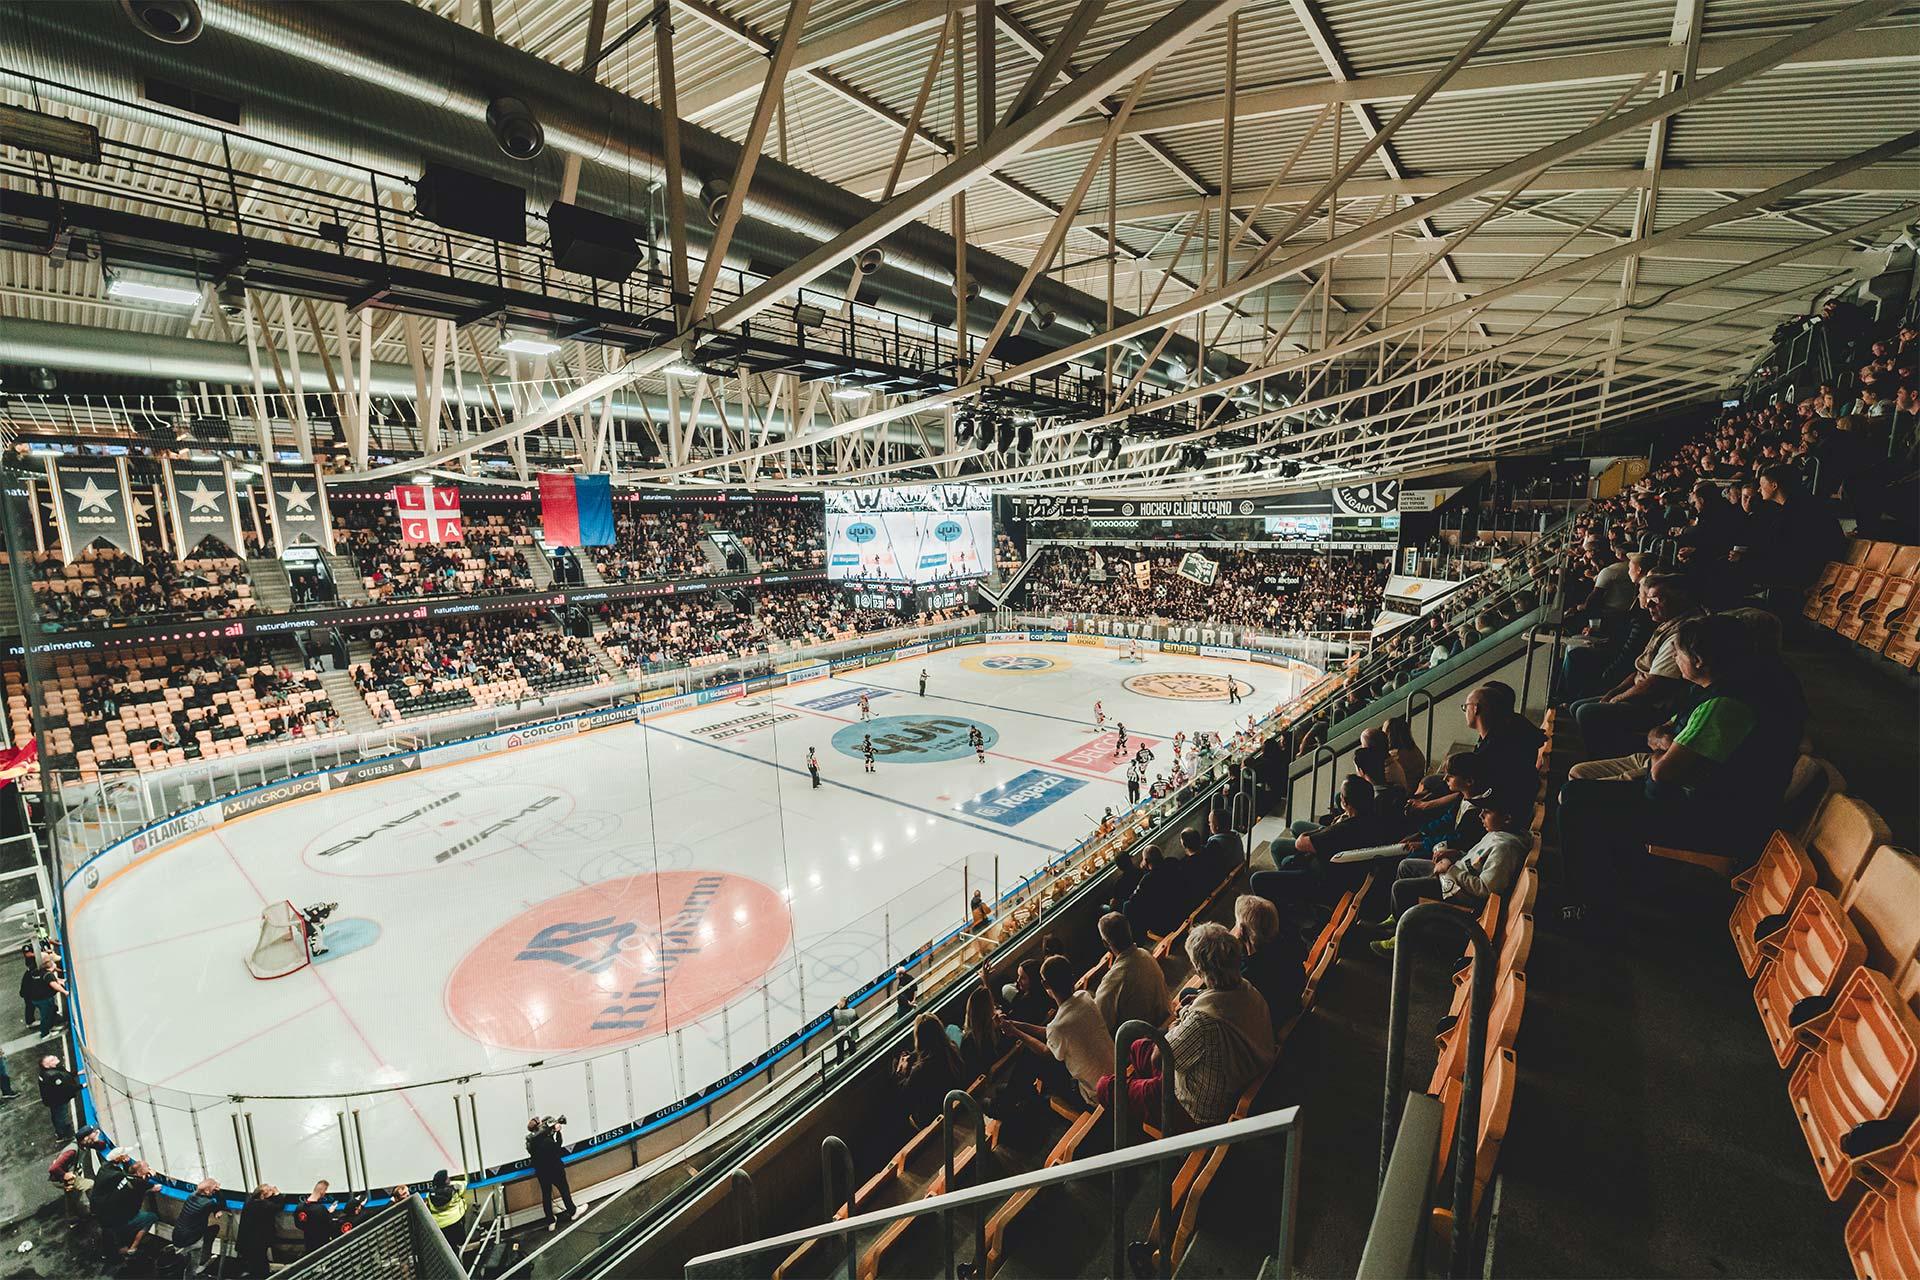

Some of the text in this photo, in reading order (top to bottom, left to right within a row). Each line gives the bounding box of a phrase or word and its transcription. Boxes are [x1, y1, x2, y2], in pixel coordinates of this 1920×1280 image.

[404, 490, 455, 507] L V
[1340, 488, 1377, 513] LUGANO
[1140, 501, 1172, 516] HOCKEY
[408, 521, 460, 539] G A
[413, 603, 481, 618] ail naturalmente.
[225, 620, 318, 637] ail naturalmente.
[1083, 619, 1234, 646] CURVA NORD
[10, 639, 95, 656] nauralmente.
[710, 686, 742, 698] ticino.com
[590, 709, 637, 724] canonica
[690, 711, 772, 735] CORRIERE
[522, 720, 574, 739] conconi
[358, 763, 395, 778] GUESS
[993, 773, 1067, 809] Regazzi
[148, 818, 189, 846] FLAME
[809, 1010, 832, 1028] GUESS
[766, 1037, 791, 1058] GUESS
[715, 1067, 744, 1089] GUESS
[588, 1126, 624, 1146] GUESS
